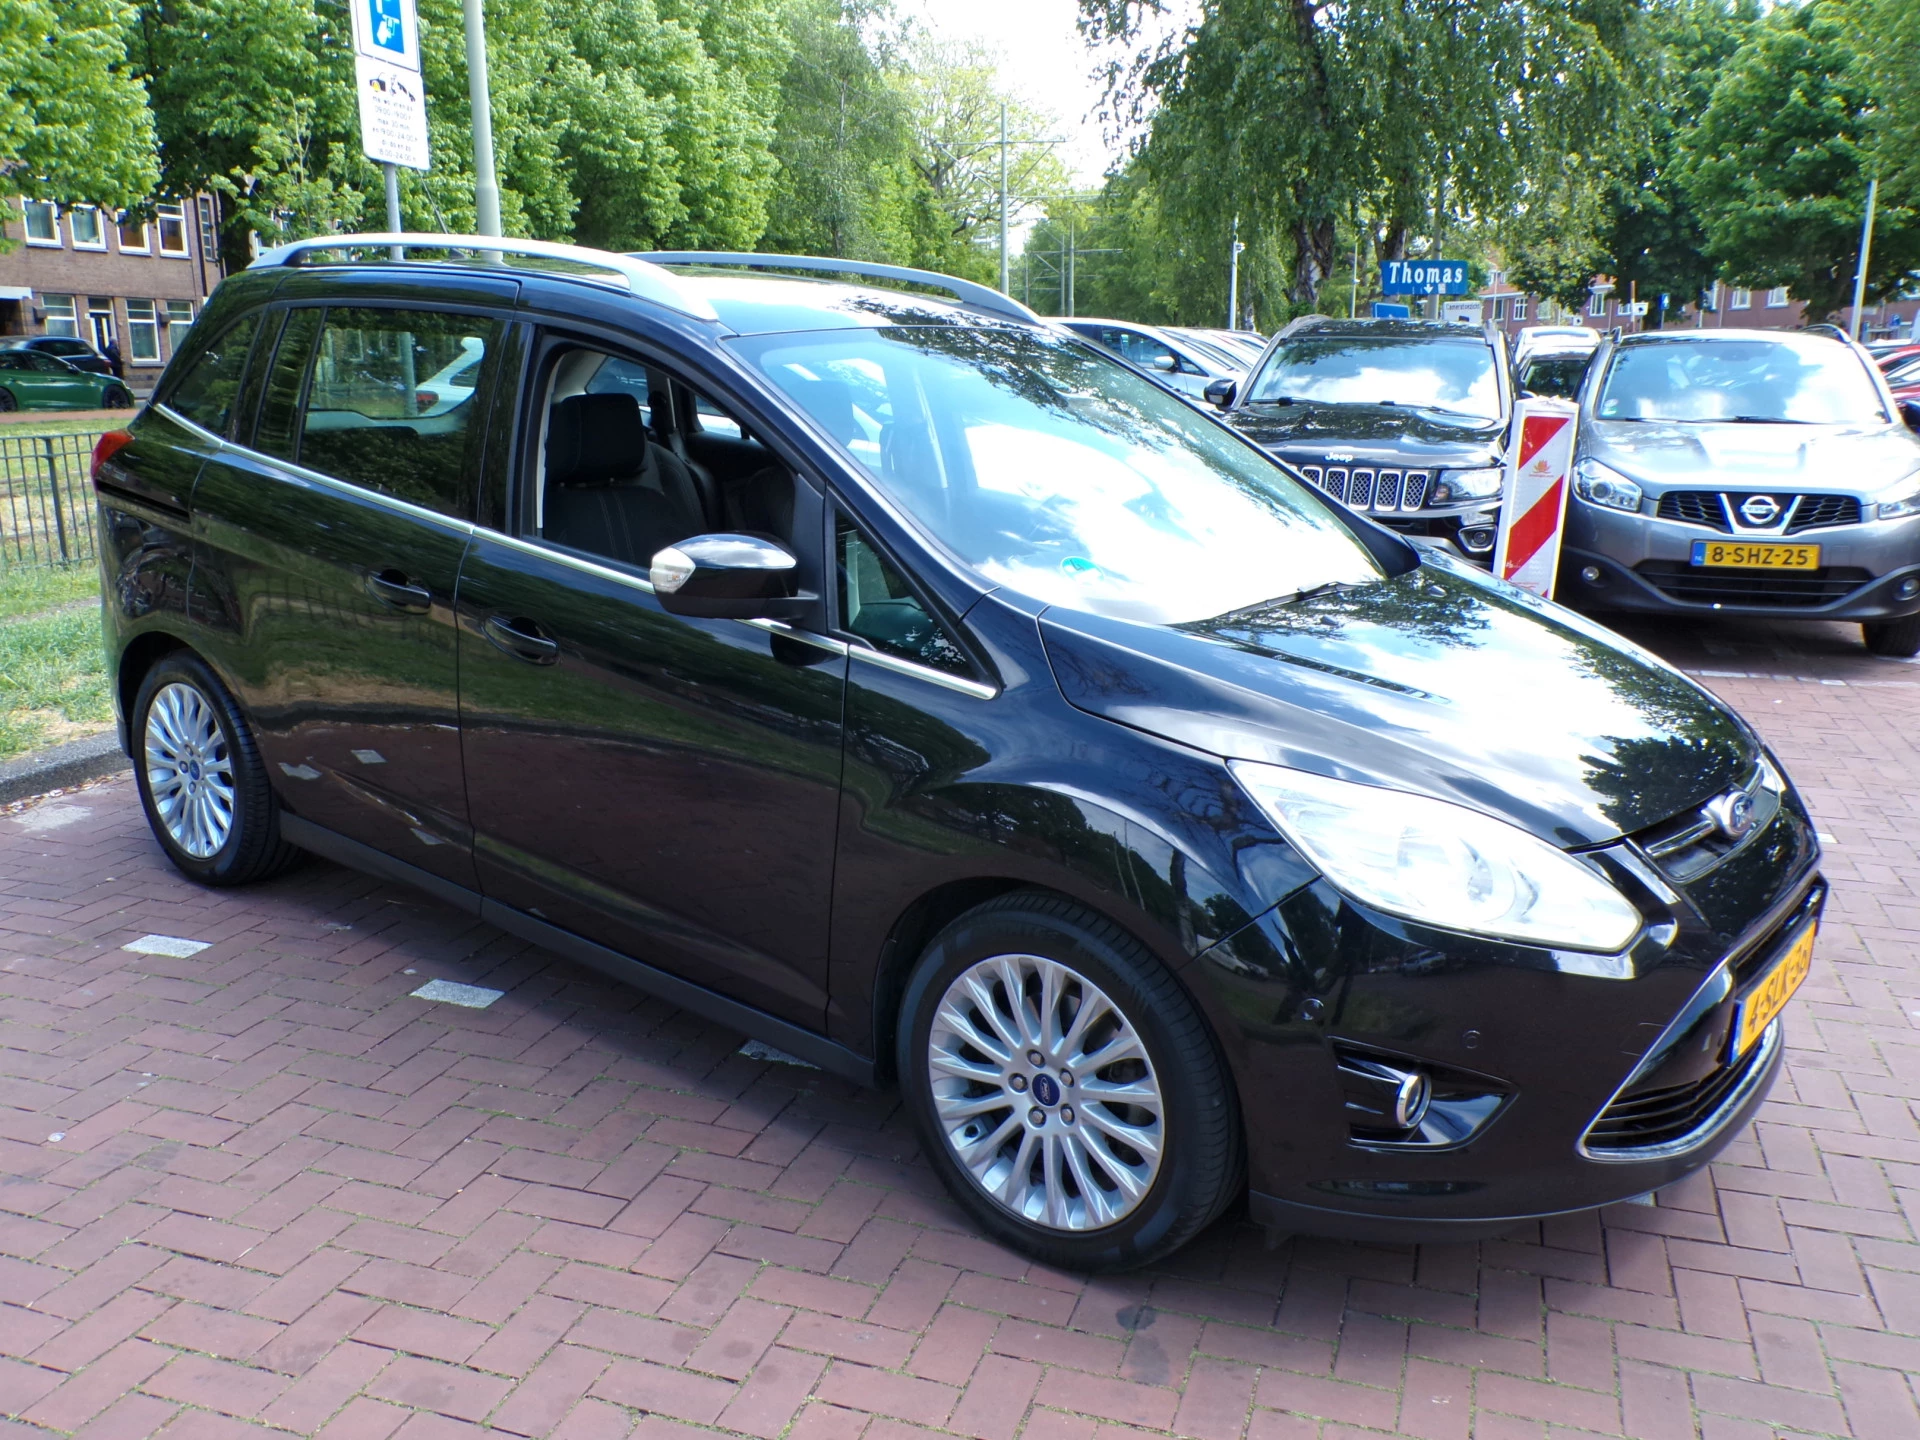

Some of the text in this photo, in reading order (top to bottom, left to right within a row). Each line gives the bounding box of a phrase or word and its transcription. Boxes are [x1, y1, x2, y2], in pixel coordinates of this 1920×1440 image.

[1389, 262, 1463, 284] Thomas
[1325, 452, 1353, 463] Jeep
[1711, 546, 1809, 566] 8-SHZ-25
